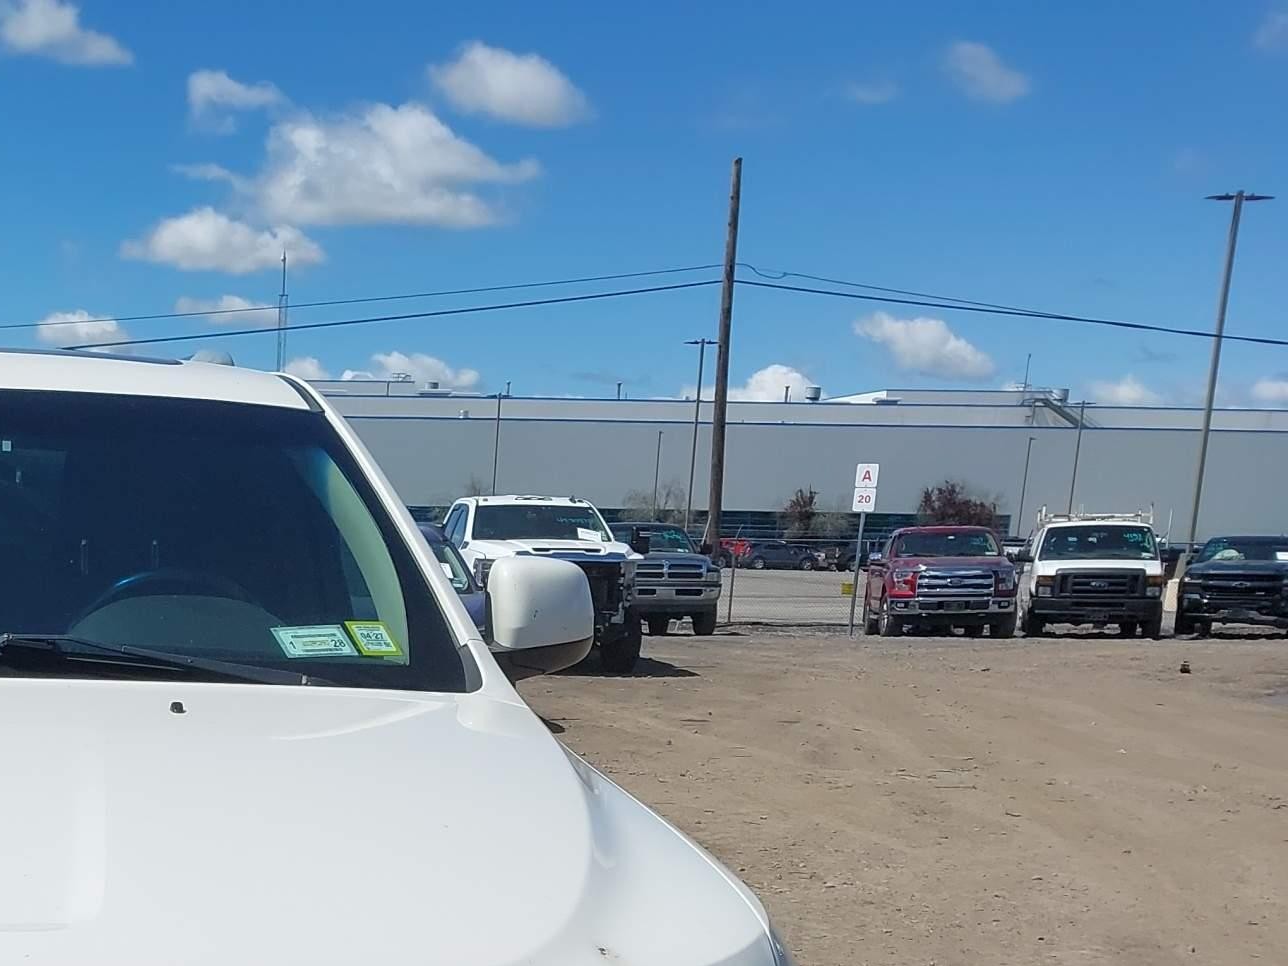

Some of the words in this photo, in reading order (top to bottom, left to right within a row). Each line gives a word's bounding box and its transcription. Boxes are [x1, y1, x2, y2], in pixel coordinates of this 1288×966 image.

[862, 470, 872, 482] A
[857, 494, 871, 504] 20
[330, 639, 346, 648] 28
